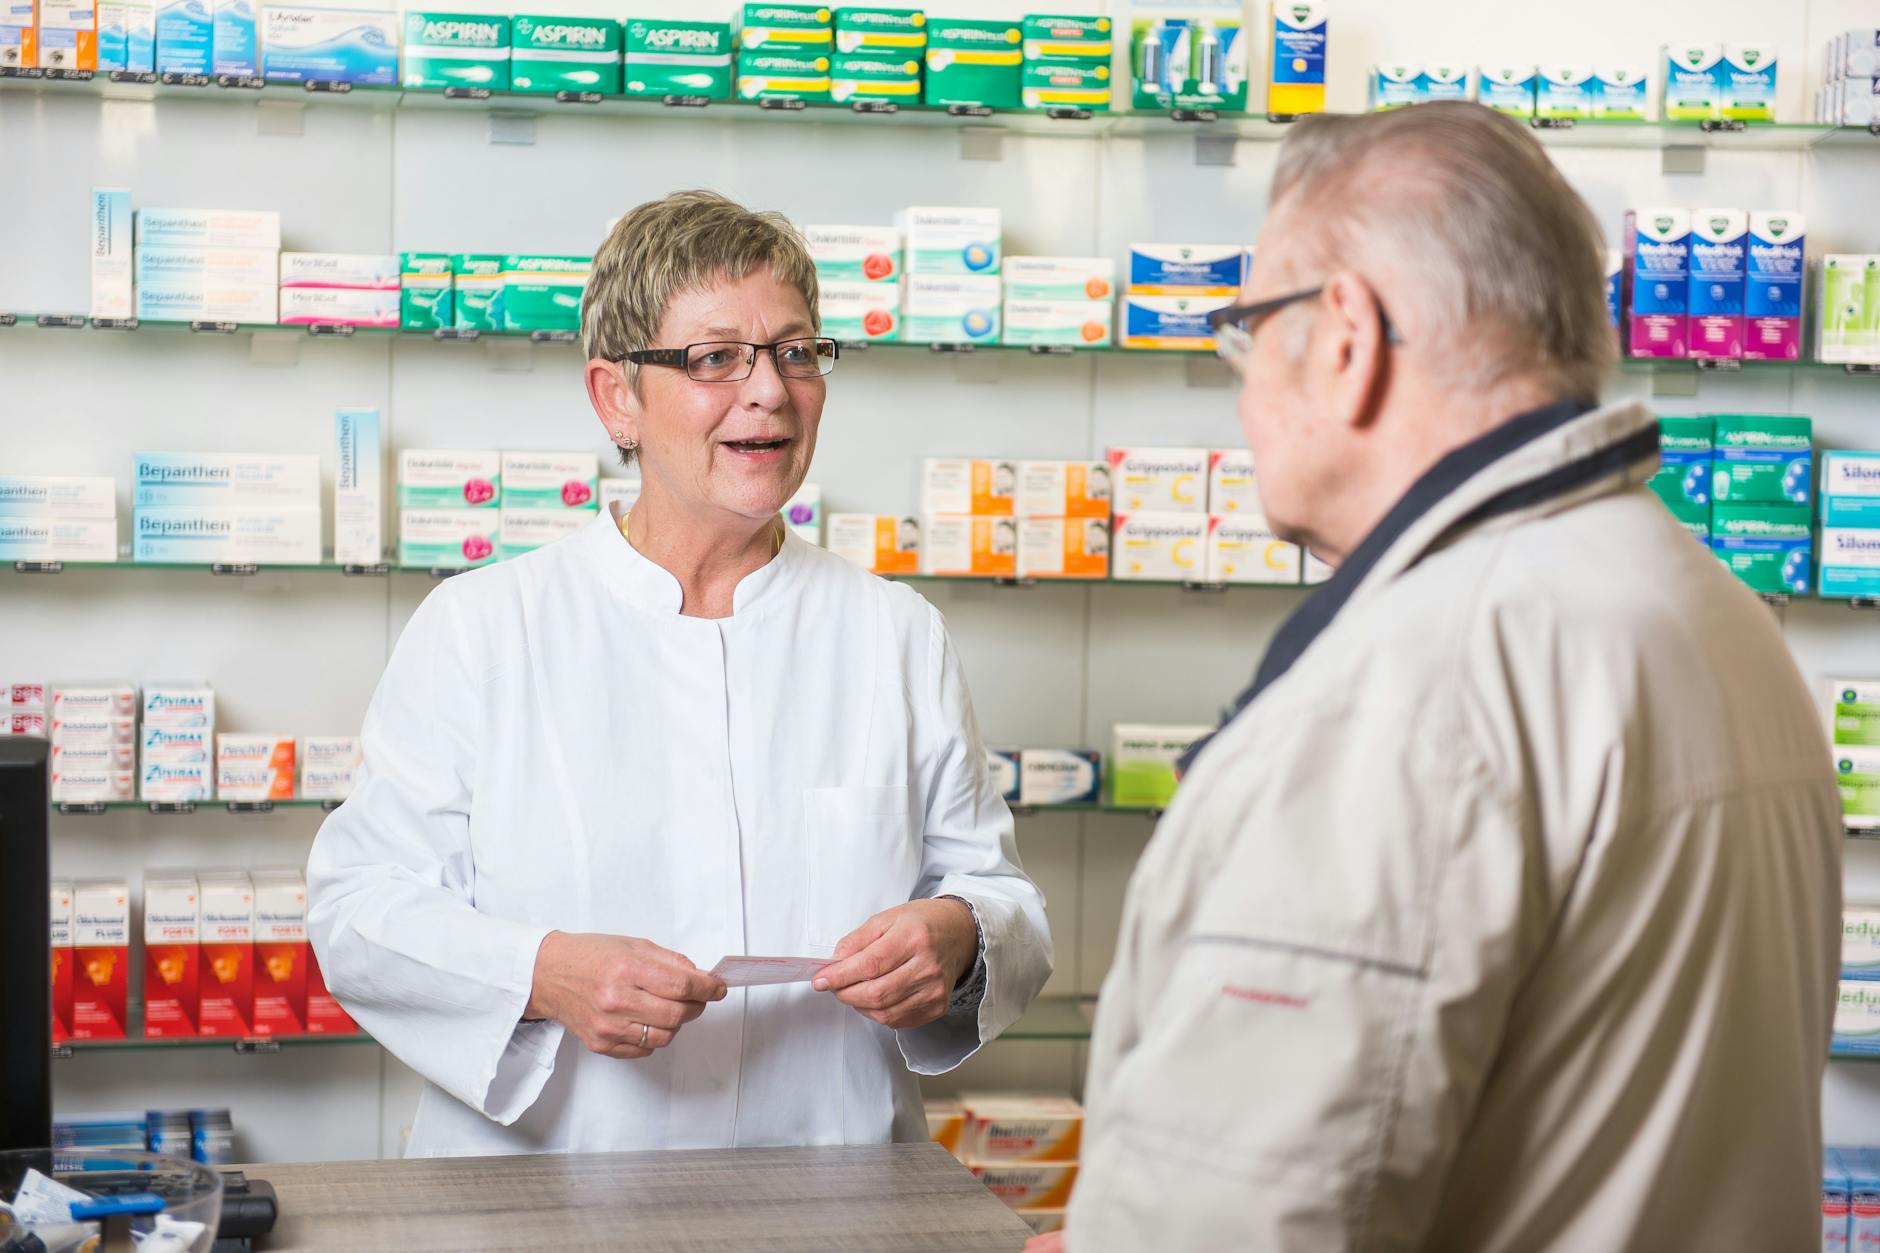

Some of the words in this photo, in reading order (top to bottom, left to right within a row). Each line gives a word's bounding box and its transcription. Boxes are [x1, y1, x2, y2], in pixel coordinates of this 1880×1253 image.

[422, 20, 500, 41] ASPIRIN
[530, 24, 606, 44] ASPIRIN
[644, 29, 719, 49] ASPIRIN
[139, 462, 230, 483] Bepanthen
[1171, 473, 1196, 504] C
[140, 516, 230, 536] Bepanthen
[1171, 538, 1196, 568] C
[1264, 540, 1288, 570] C
